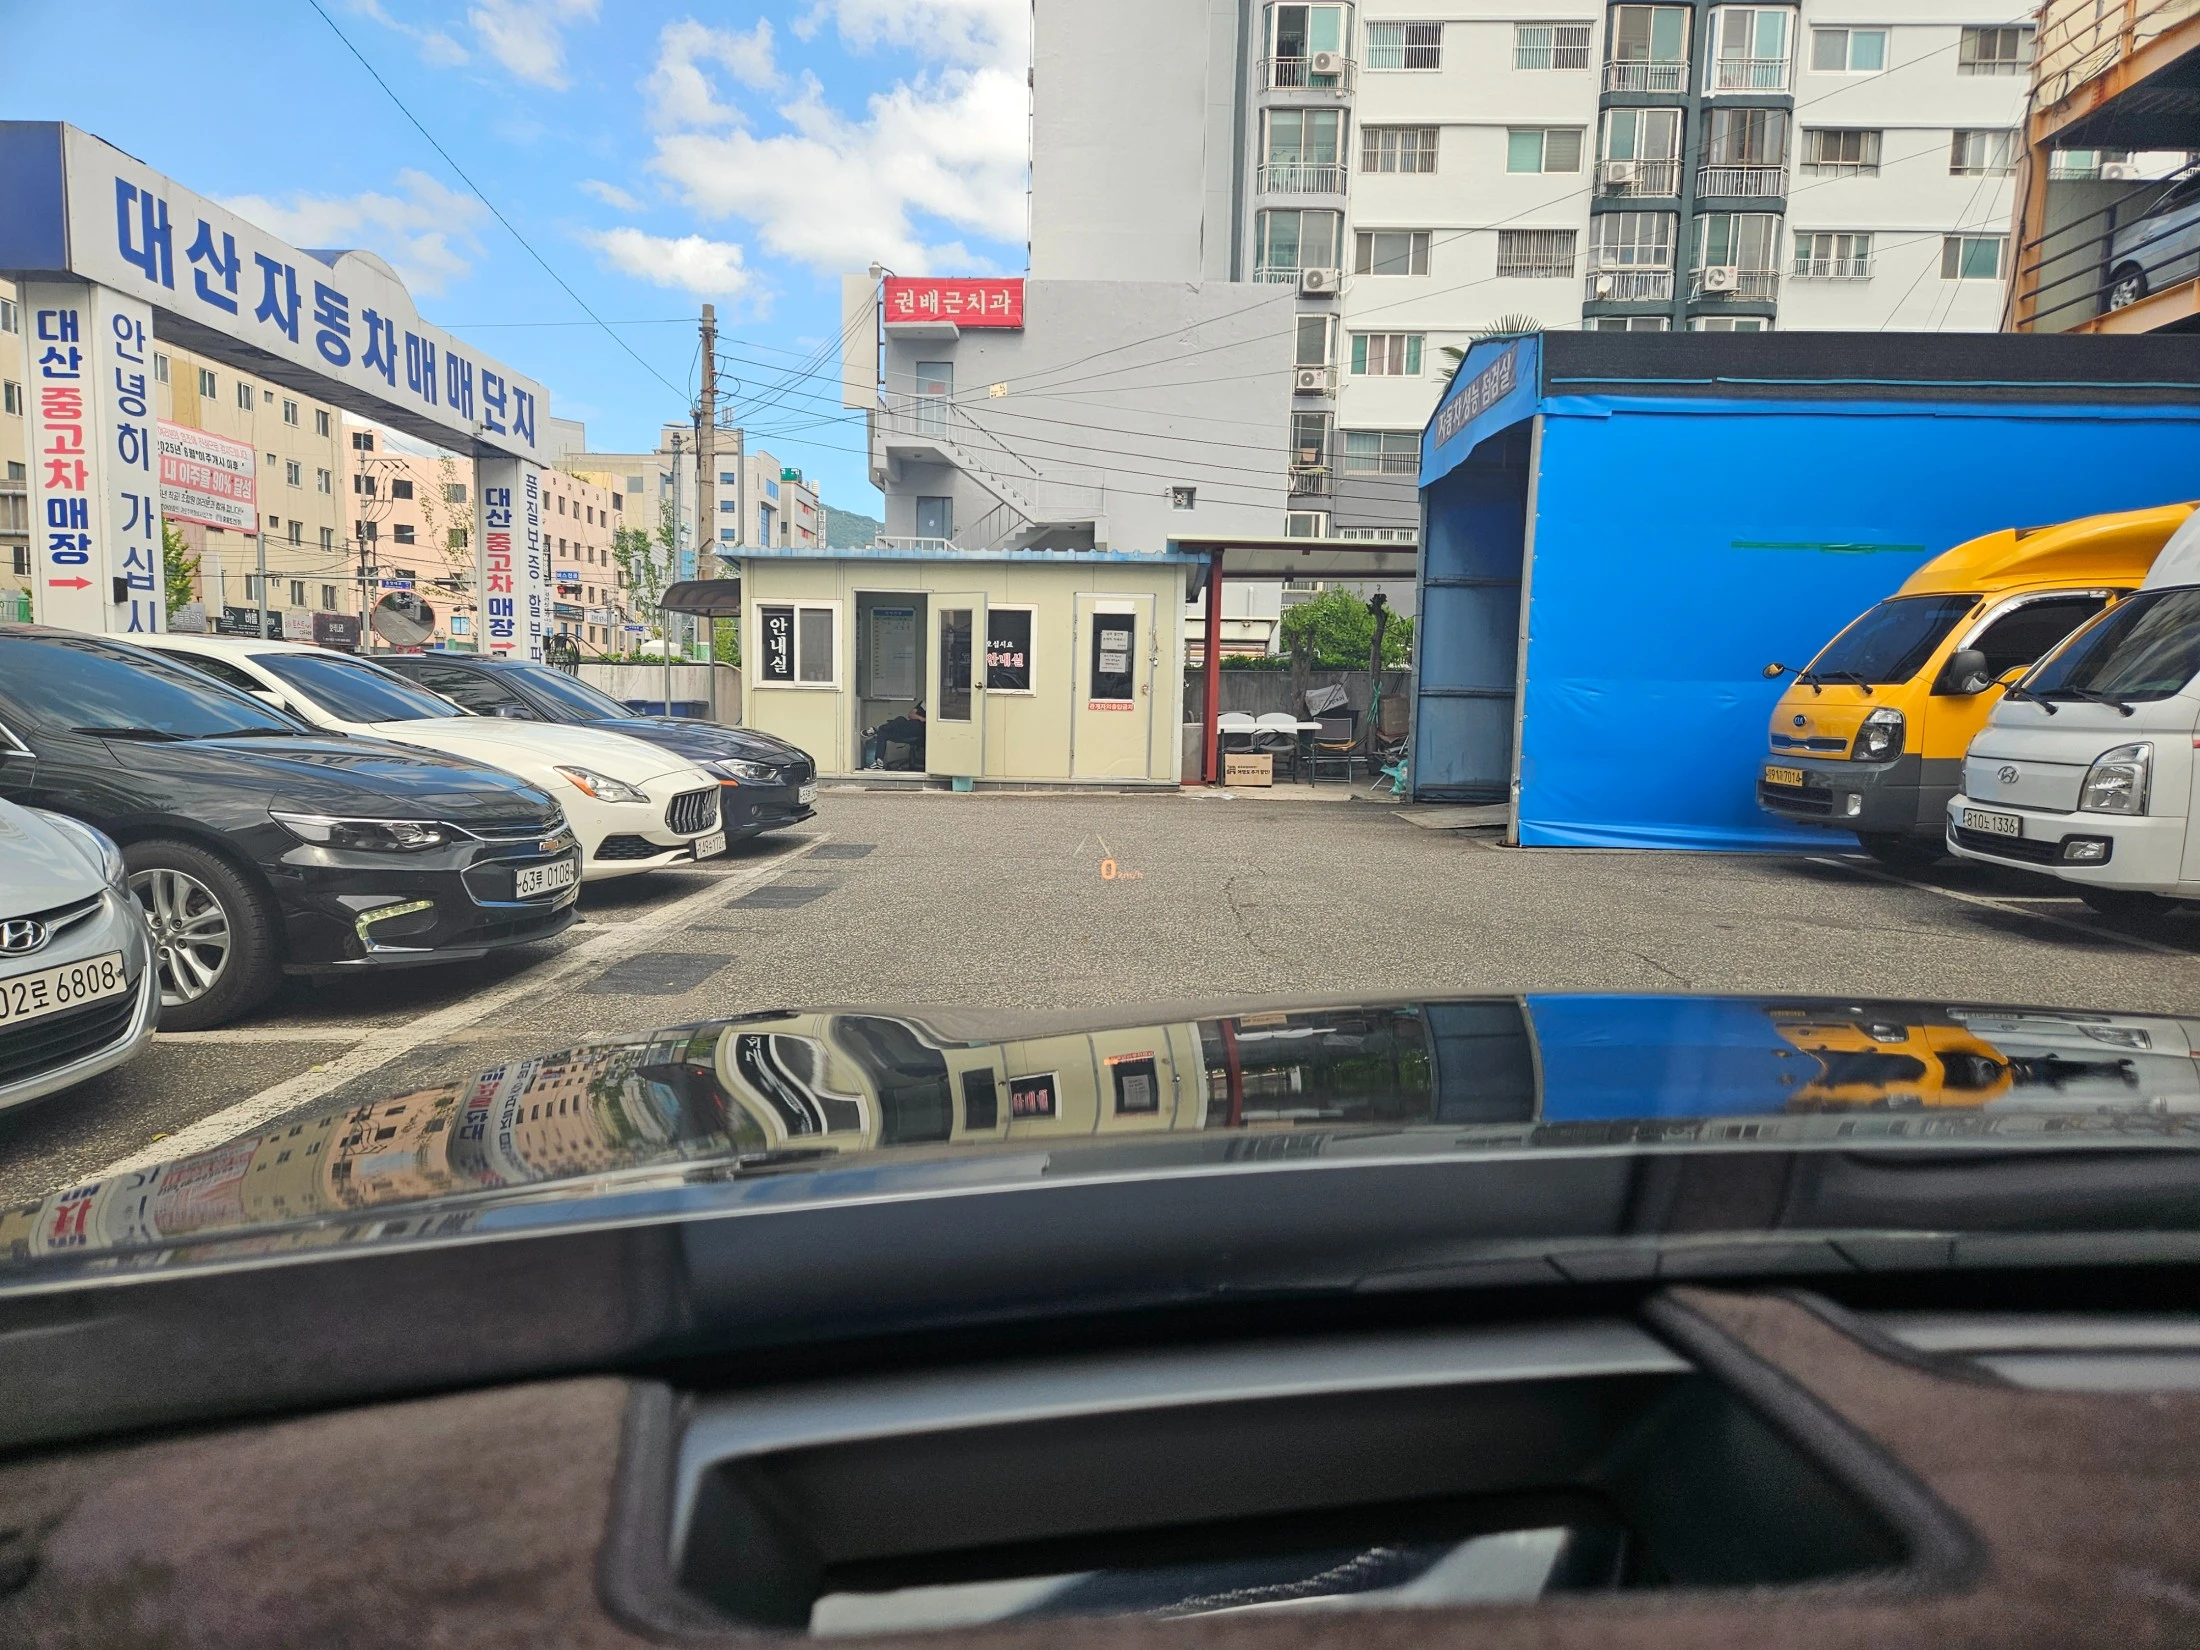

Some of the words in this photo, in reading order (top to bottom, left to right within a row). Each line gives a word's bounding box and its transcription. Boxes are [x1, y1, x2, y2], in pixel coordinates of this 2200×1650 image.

[115, 176, 535, 448] 대산자동차매매단지
[894, 288, 1012, 315] 권배근치과
[37, 309, 83, 379] 대산
[112, 313, 150, 472] 안녕히
[41, 387, 89, 492] 중고차
[157, 440, 182, 456] 025년
[183, 446, 196, 460] 6월
[198, 451, 225, 468] 이주개시
[226, 459, 239, 471] 이후
[212, 471, 232, 494] 90%
[233, 476, 252, 499] 달성
[485, 487, 513, 529] 대산
[526, 473, 541, 580] 품질보증
[46, 497, 92, 565] 매장
[486, 532, 514, 594] 중고차
[488, 597, 515, 638] 매장
[769, 616, 788, 674] 안내실
[987, 652, 1024, 668] 안내실
[1967, 812, 1990, 829] 810노
[1992, 816, 2015, 834] 1336
[522, 870, 543, 893] 63루
[547, 862, 570, 887] 0108
[1101, 858, 1117, 881] 0
[56, 960, 116, 1003] 6808
